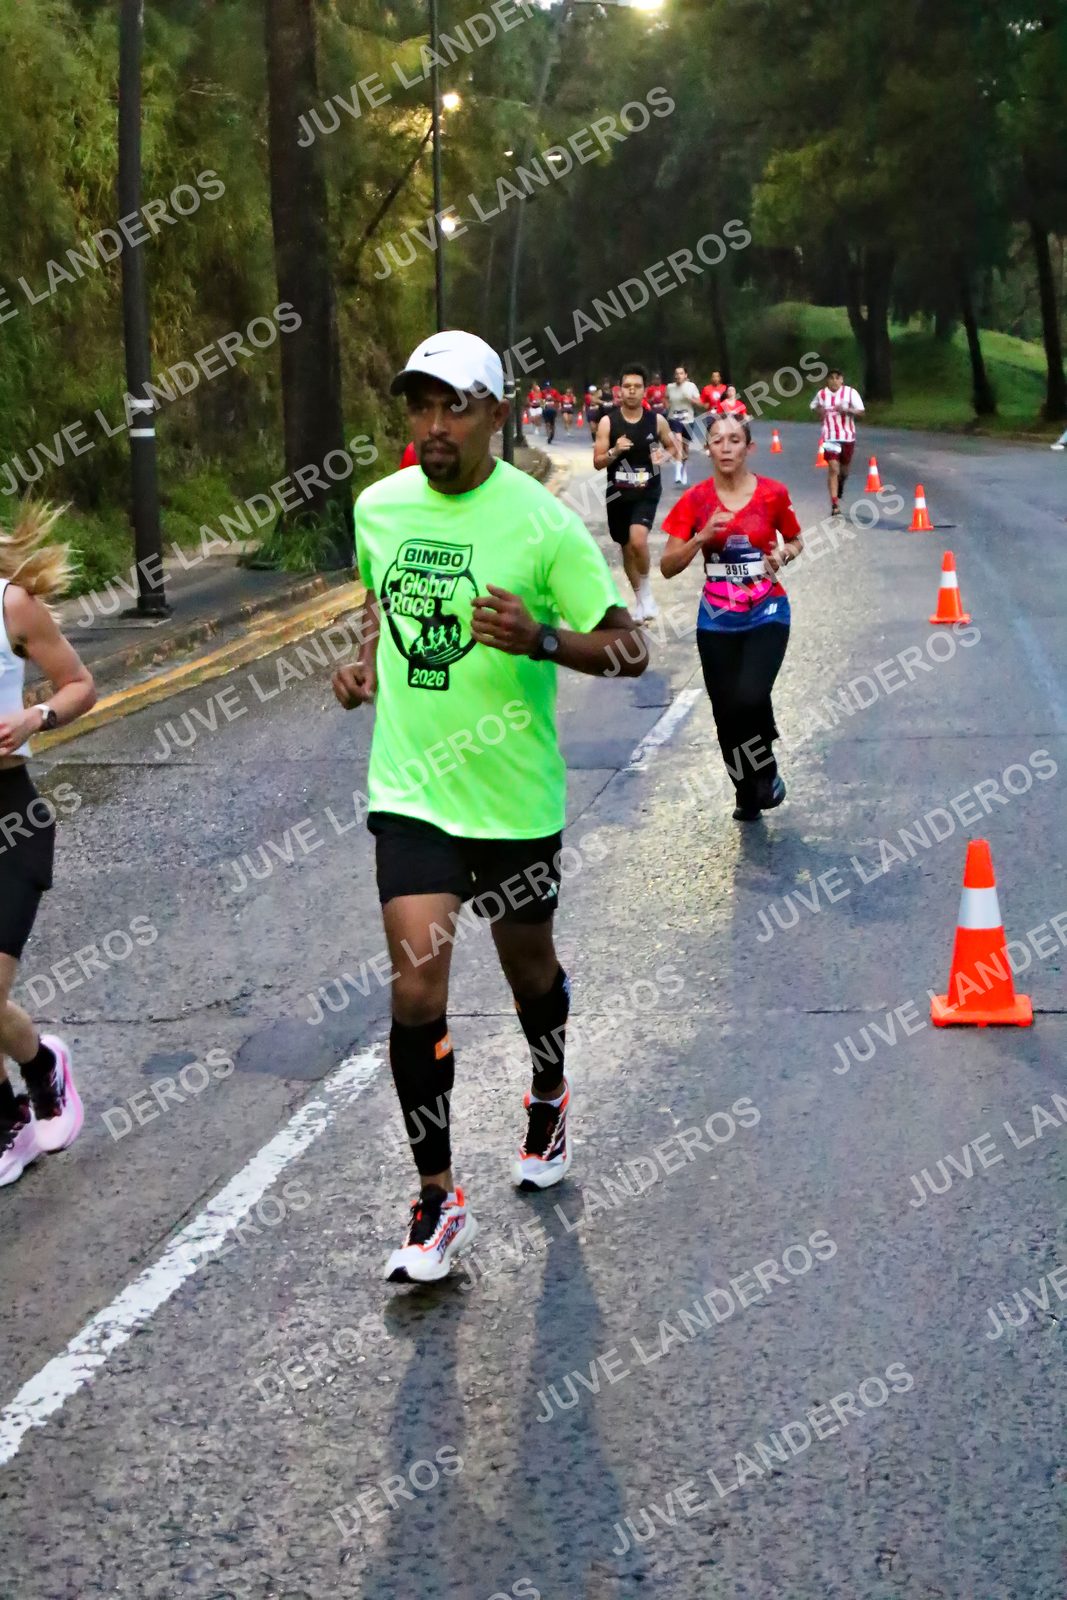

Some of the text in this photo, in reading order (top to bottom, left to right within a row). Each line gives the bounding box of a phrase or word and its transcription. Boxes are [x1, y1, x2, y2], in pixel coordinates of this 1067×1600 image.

[404, 548, 464, 567] BIMBO
[725, 564, 749, 576] 3915
[400, 572, 456, 599] Global
[389, 592, 435, 618] Race
[410, 668, 446, 687] 2026
